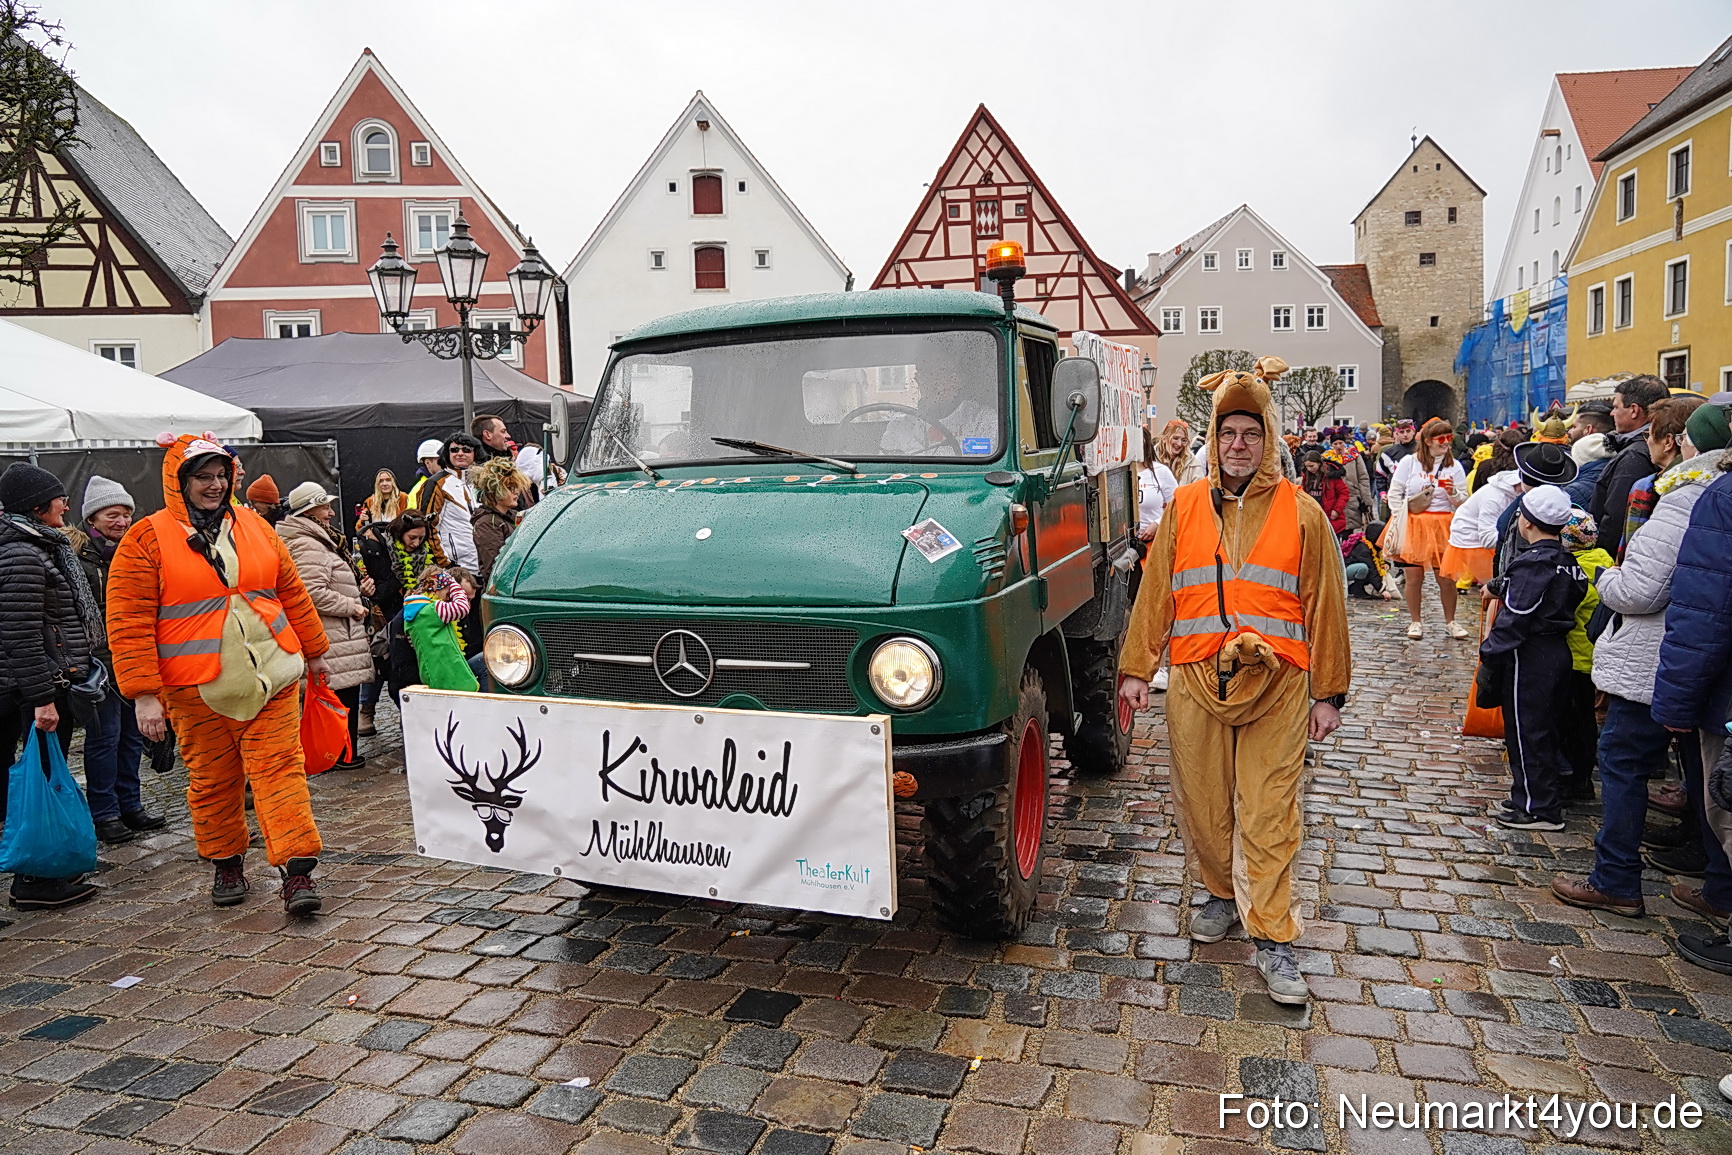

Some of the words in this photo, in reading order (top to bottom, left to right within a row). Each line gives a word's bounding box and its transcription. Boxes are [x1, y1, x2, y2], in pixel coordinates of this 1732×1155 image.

[598, 729, 798, 818] Kirwaleid
[579, 819, 731, 869] Mühlhausen
[795, 858, 871, 884] TheaterKult
[801, 878, 842, 890] Mühlhausen
